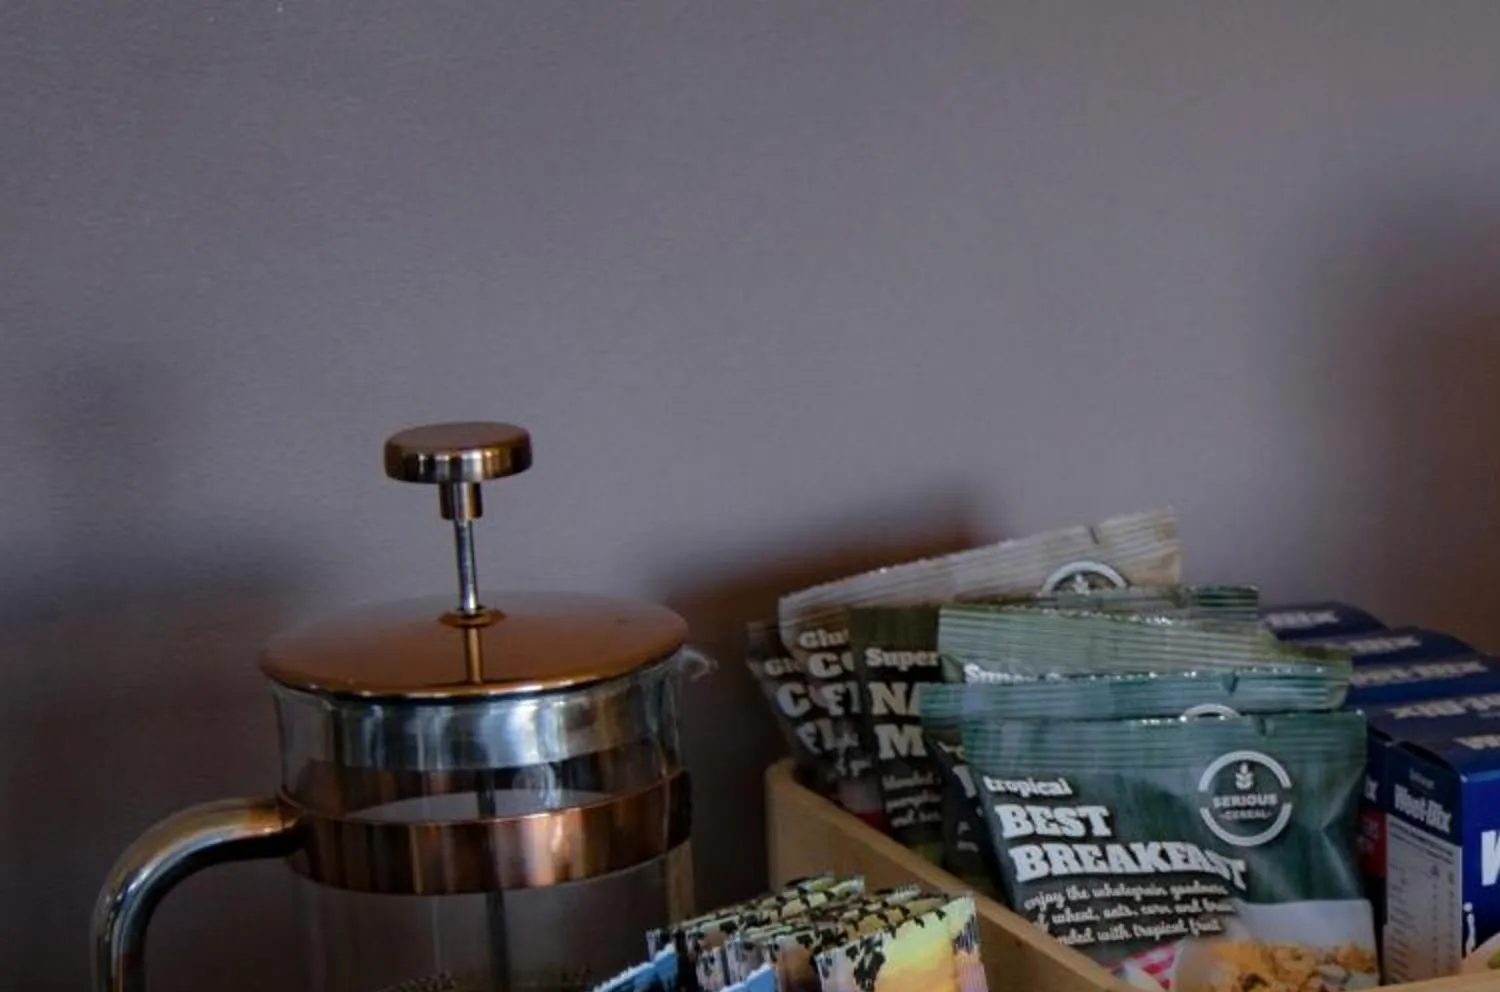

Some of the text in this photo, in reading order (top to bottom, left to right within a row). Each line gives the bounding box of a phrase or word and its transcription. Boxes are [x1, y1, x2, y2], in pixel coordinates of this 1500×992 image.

[865, 647, 940, 671] Super
[984, 776, 1072, 797] tropical
[1212, 792, 1278, 808] SERIOUS
[995, 804, 1112, 838] BEST
[1009, 841, 1247, 890] BREAKFAST
